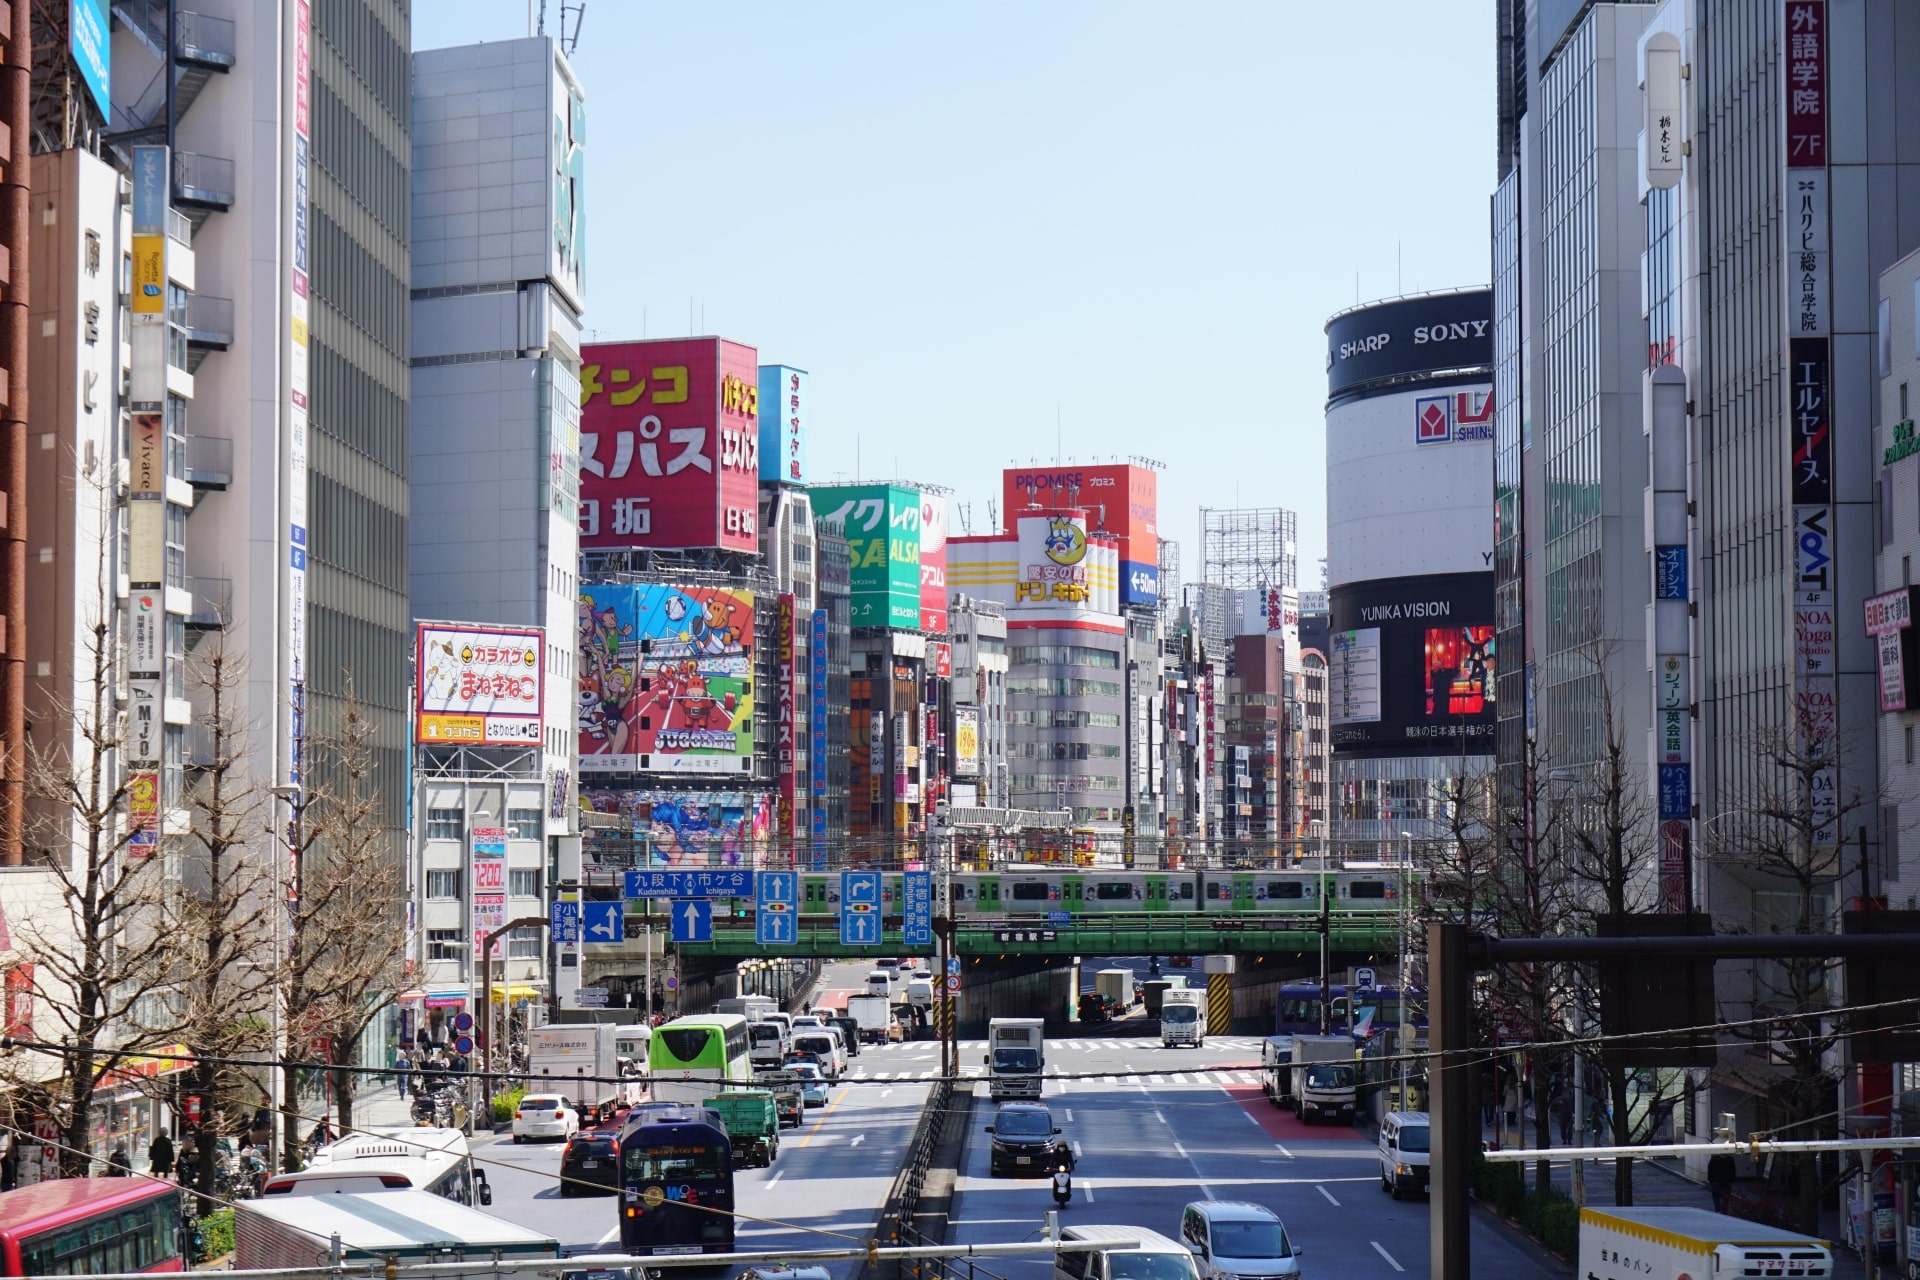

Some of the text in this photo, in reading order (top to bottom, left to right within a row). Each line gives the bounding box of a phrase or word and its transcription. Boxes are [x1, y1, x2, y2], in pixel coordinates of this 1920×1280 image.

[1792, 5, 1820, 115] 外語学院
[1792, 134, 1821, 157] 7F
[1800, 195, 1817, 331] ハクビ総合学院
[142, 314, 154, 322] 7F
[1414, 320, 1489, 345] SONY
[1340, 333, 1391, 360] SHARP
[723, 371, 758, 416] パチンコ
[1796, 362, 1821, 485] エルセーヌ
[723, 422, 758, 470] エスパス
[1015, 472, 1083, 490] PROMISE
[1089, 477, 1116, 487] プロミス
[727, 505, 755, 534] 日拓
[889, 503, 919, 531] レイク
[889, 538, 919, 565] ALSA
[920, 564, 945, 587] アコム
[1667, 549, 1680, 597] オアシス
[1806, 593, 1821, 603] 4F
[1361, 601, 1450, 622] YUNIKA VISION
[1795, 611, 1832, 625] NOA
[780, 602, 791, 661] パチンコ
[1795, 629, 1832, 644] Yoga
[474, 647, 523, 666] カラオケ
[1798, 647, 1830, 655] Studio
[460, 668, 536, 702] まねきねこ
[779, 664, 792, 744] エスパス
[1797, 692, 1834, 706] NOA
[444, 726, 481, 738] ワンカラ
[487, 723, 538, 738] となりのビル 4F
[655, 729, 737, 752] JUGGLER
[871, 723, 880, 767] 小松ビル
[601, 758, 628, 767] 北電子
[695, 759, 720, 768] 北電子
[634, 873, 682, 889] 九段下
[686, 880, 693, 888] 4
[638, 889, 736, 897] Kudanshita Ichigaya
[906, 876, 916, 910] Shinjuku
[915, 875, 928, 941] 新宿駅東口
[562, 904, 577, 940] 小滝橋
